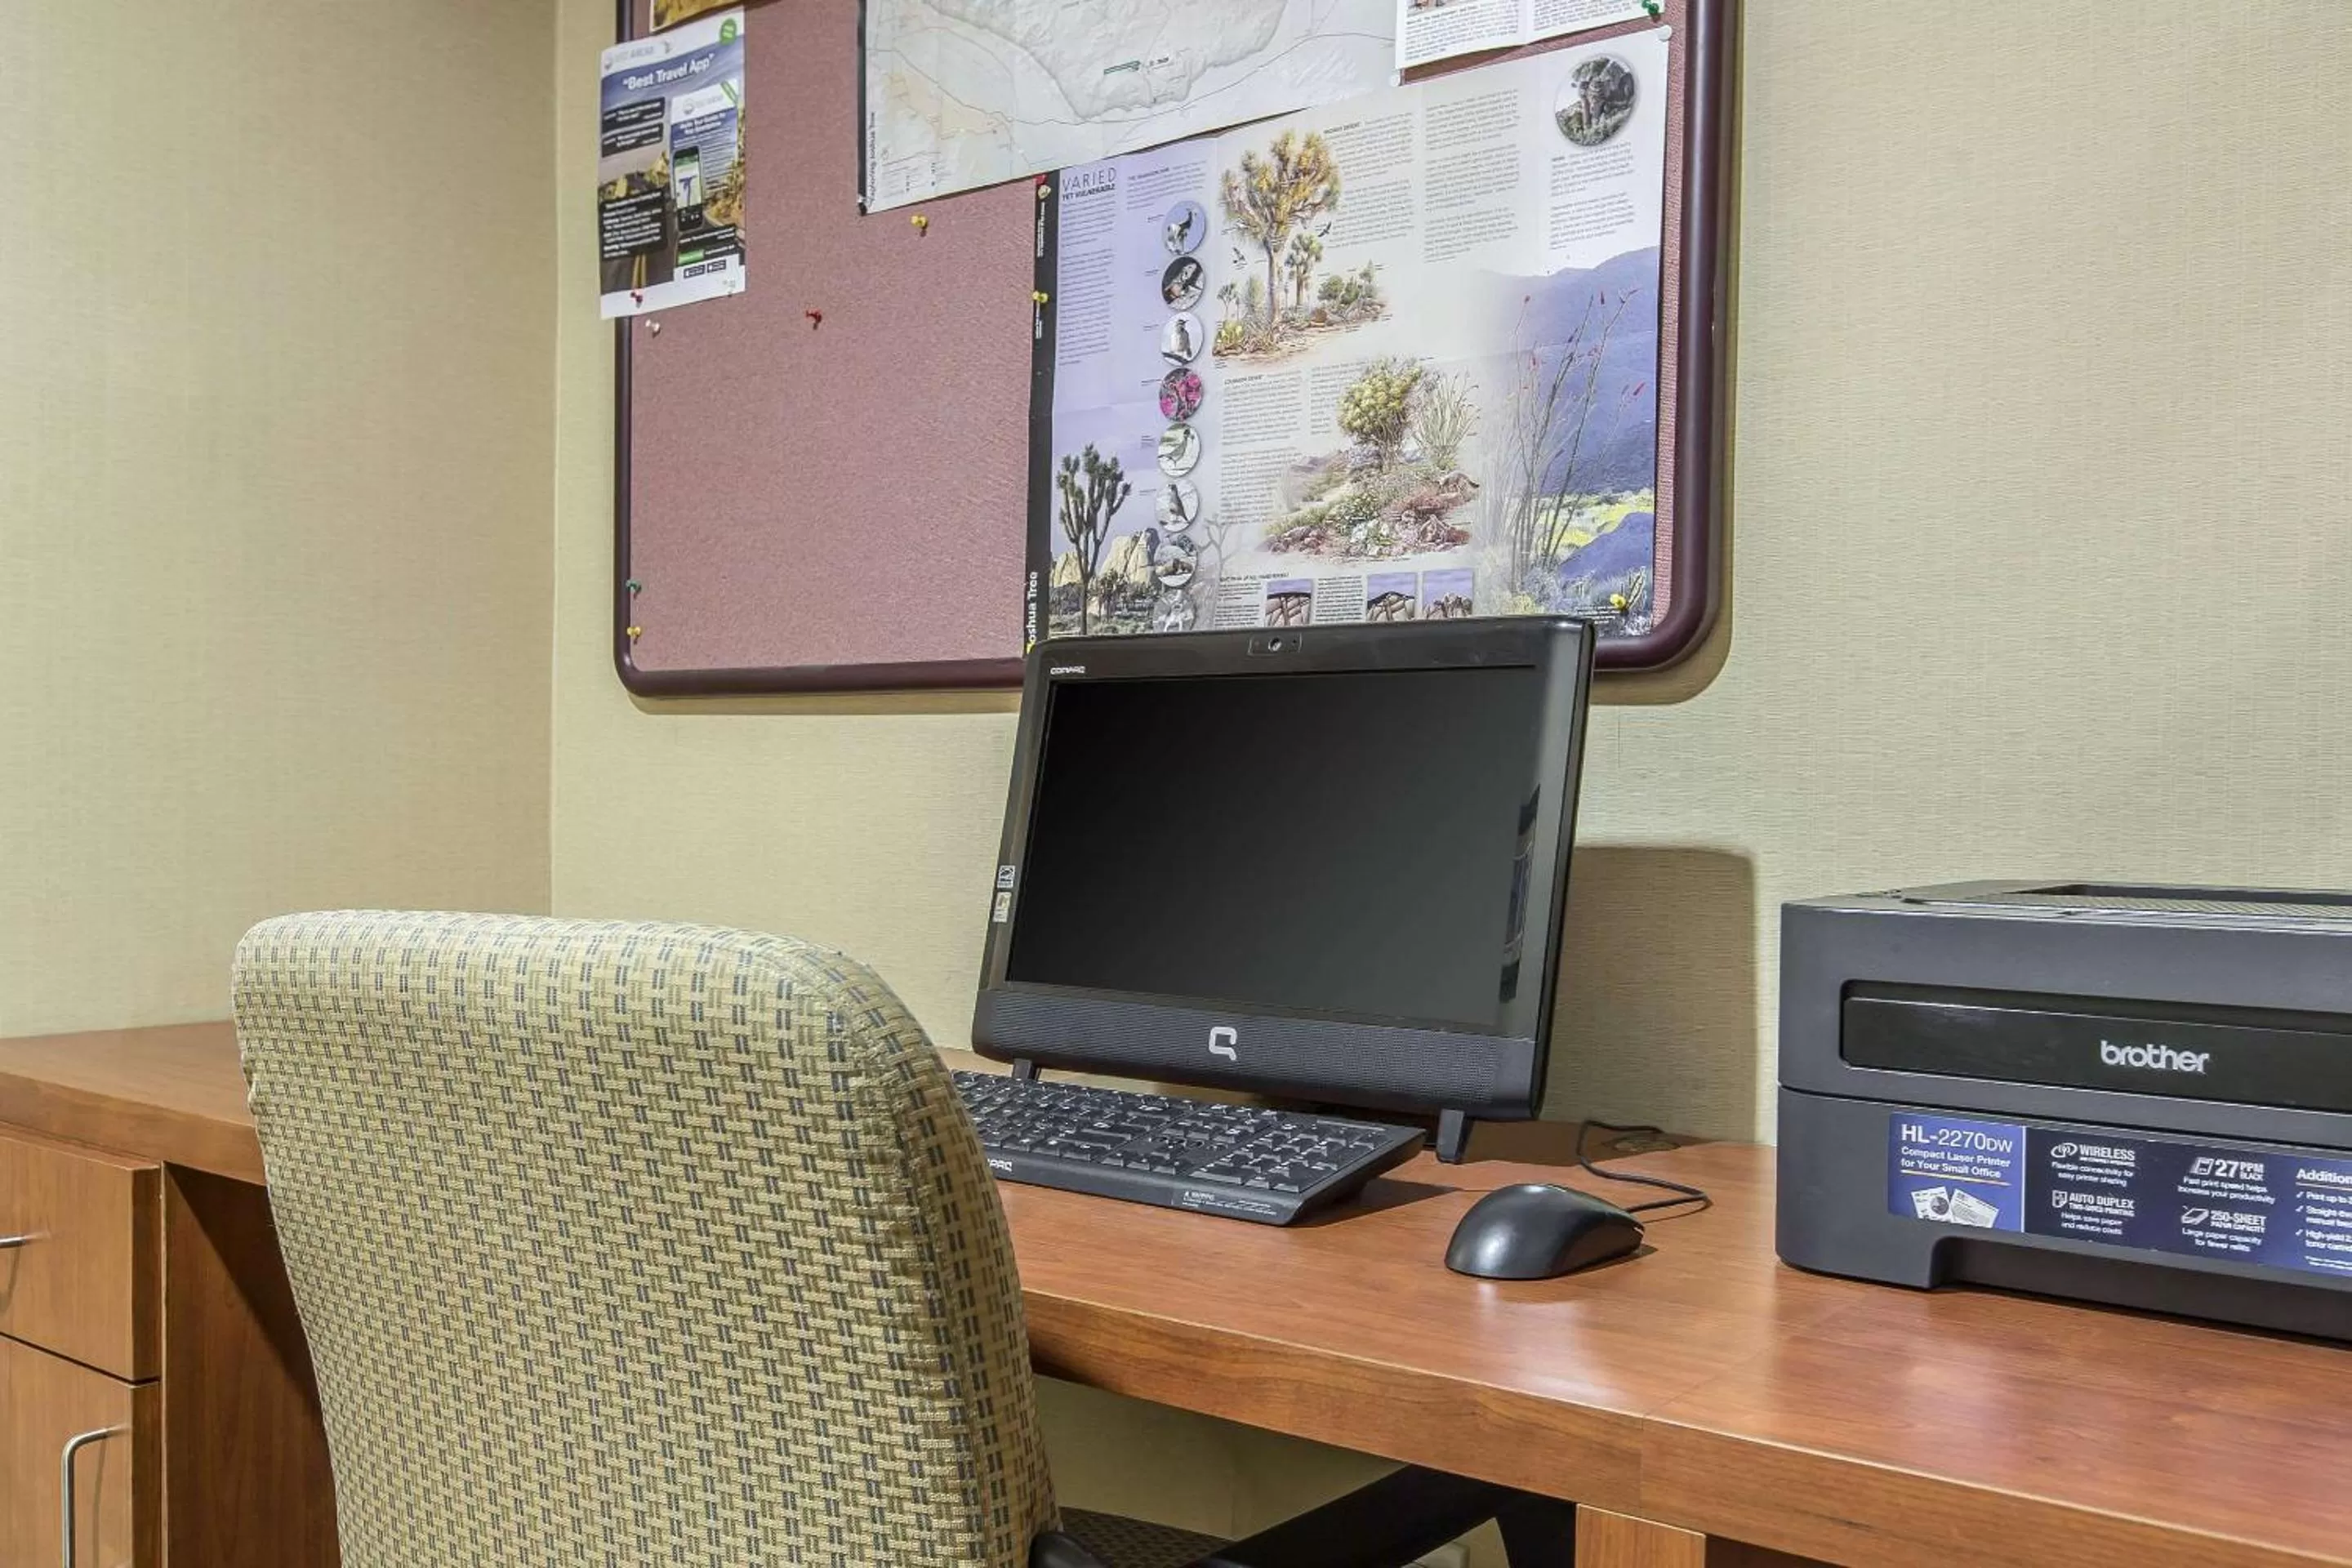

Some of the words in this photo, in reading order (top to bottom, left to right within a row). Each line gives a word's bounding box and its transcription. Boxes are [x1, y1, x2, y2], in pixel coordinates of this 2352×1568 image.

[656, 63, 688, 82] Travel
[1062, 167, 1116, 192] VARIED
[1027, 572, 1038, 600] Tree
[1026, 603, 1037, 644] oshua
[2100, 1040, 2210, 1072] brother
[1900, 1124, 2013, 1153] HL-2270DW
[1901, 1146, 1945, 1160] Compact
[1947, 1152, 1975, 1163] Laser
[1976, 1155, 2011, 1167] Printer
[2079, 1143, 2136, 1160] WIRELESS
[987, 1158, 1013, 1172] PAQ
[1901, 1158, 1915, 1168] for
[1917, 1159, 1939, 1170] Your
[1942, 1163, 1969, 1174] Small
[1971, 1166, 2001, 1178] Office
[2215, 1158, 2239, 1178] 27
[2239, 1160, 2265, 1174] PPM
[2239, 1172, 2264, 1181] BLACK
[2069, 1192, 2095, 1205] AUTO
[2096, 1196, 2135, 1209] DUPLEX
[2210, 1209, 2266, 1226] 250-SHEET
